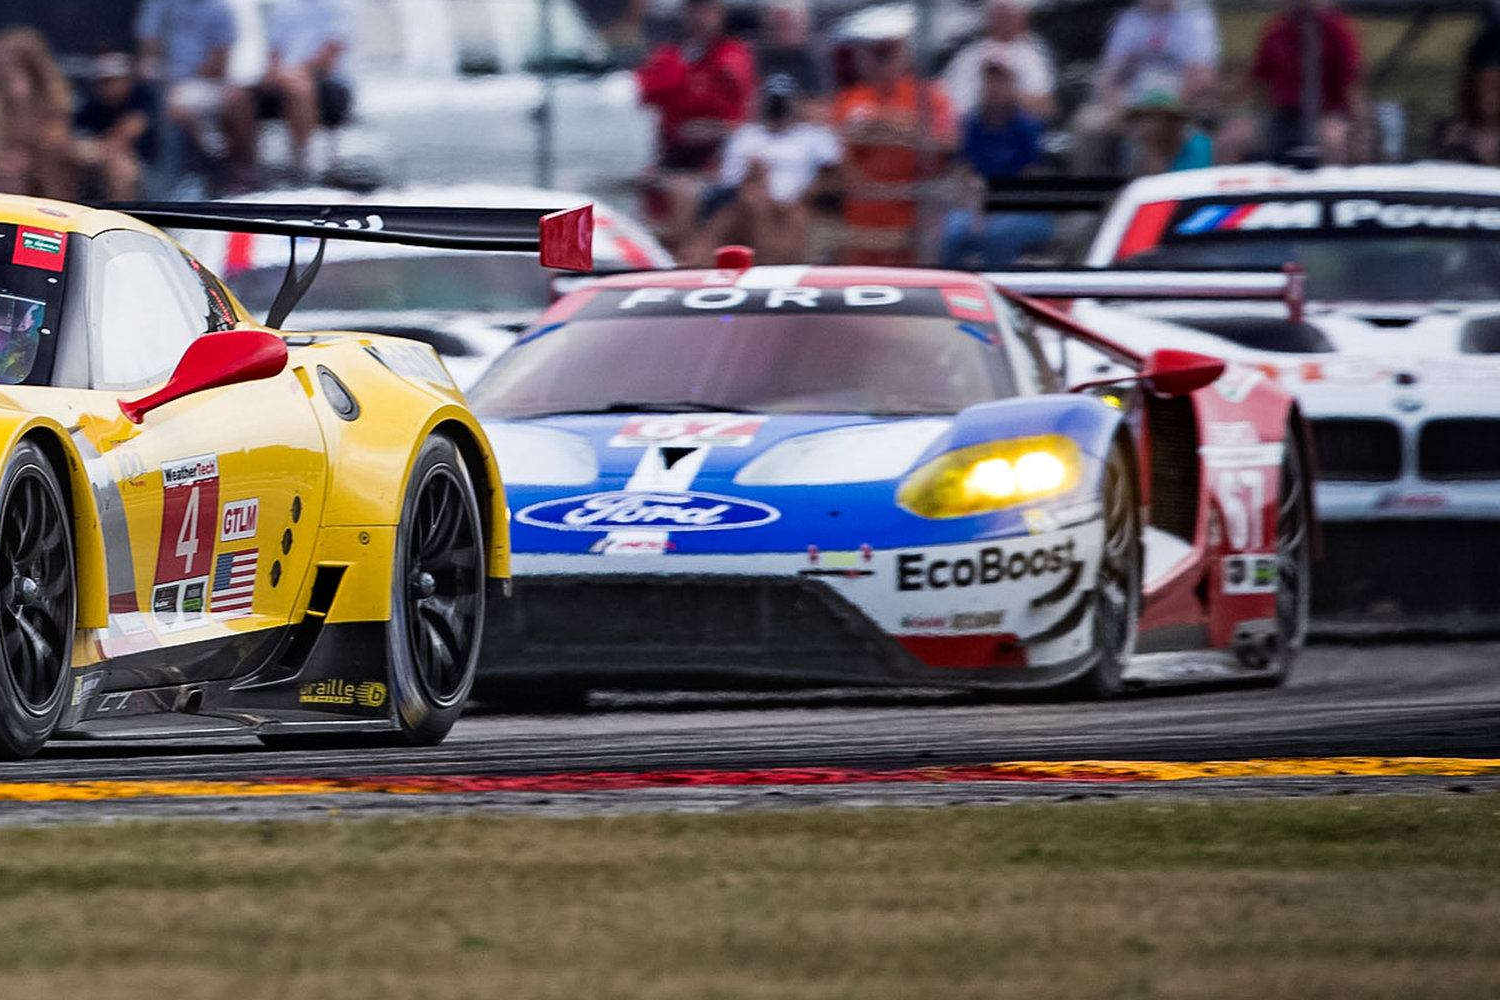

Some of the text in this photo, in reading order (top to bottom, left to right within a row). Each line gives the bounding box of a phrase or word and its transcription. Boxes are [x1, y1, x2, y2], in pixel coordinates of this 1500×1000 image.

[618, 285, 904, 309] FORD
[164, 461, 216, 482] WeatherTech
[224, 504, 258, 535] GTLM
[562, 494, 731, 526] Ford
[175, 486, 200, 574] 4
[897, 537, 1076, 591] EcoBoost
